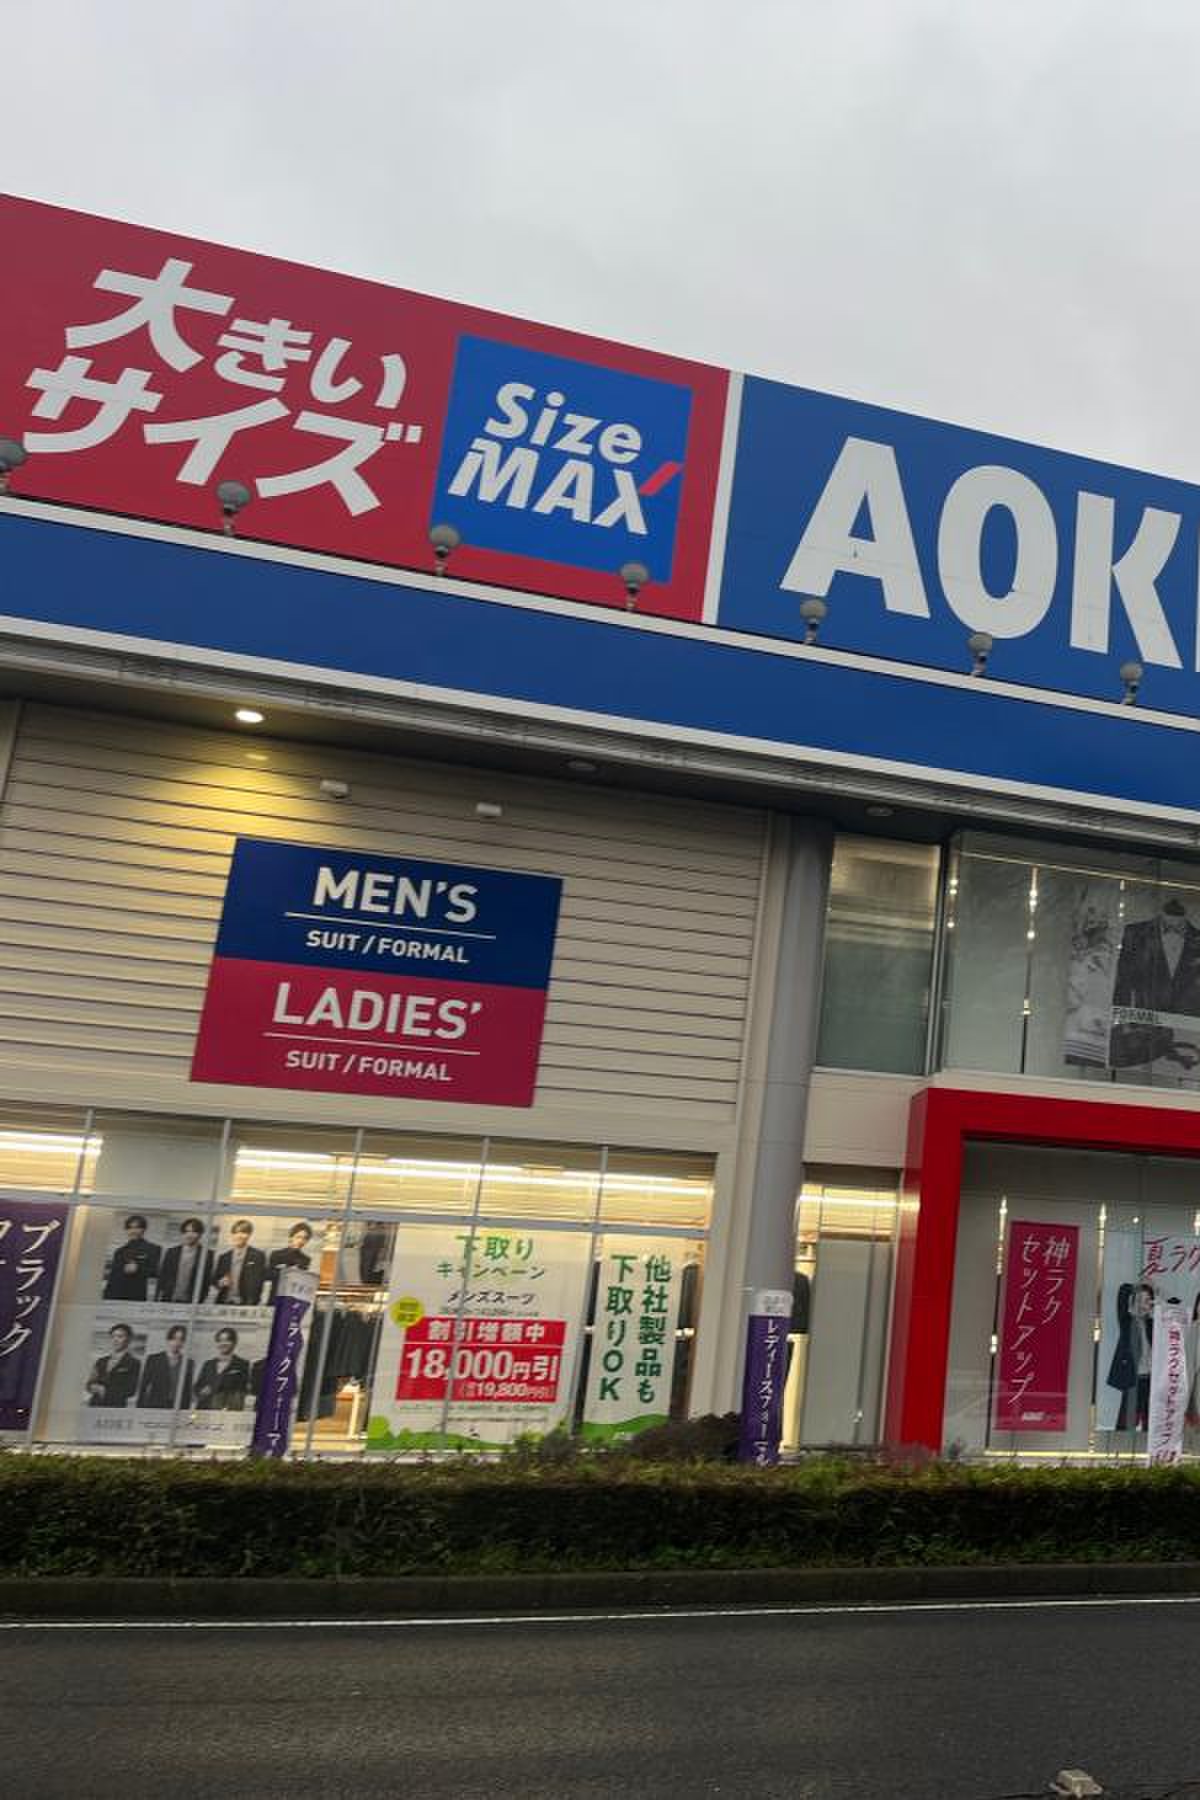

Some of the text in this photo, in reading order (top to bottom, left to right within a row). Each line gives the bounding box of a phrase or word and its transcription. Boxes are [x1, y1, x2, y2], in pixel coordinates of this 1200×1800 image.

[66, 258, 407, 408] 大きい
[23, 356, 422, 517] サイズ
[485, 382, 643, 463] Size
[447, 438, 684, 535] MAX
[313, 867, 477, 923] MEN'S
[272, 982, 481, 1040] LADIES'
[0, 1219, 61, 1357] ブラック
[456, 1235, 534, 1259] 下取り
[1041, 1235, 1070, 1325] 神ラク
[600, 1254, 638, 1401] 下取りOK
[635, 1255, 671, 1403] 他社製品も
[1008, 1235, 1040, 1404] セットアップ
